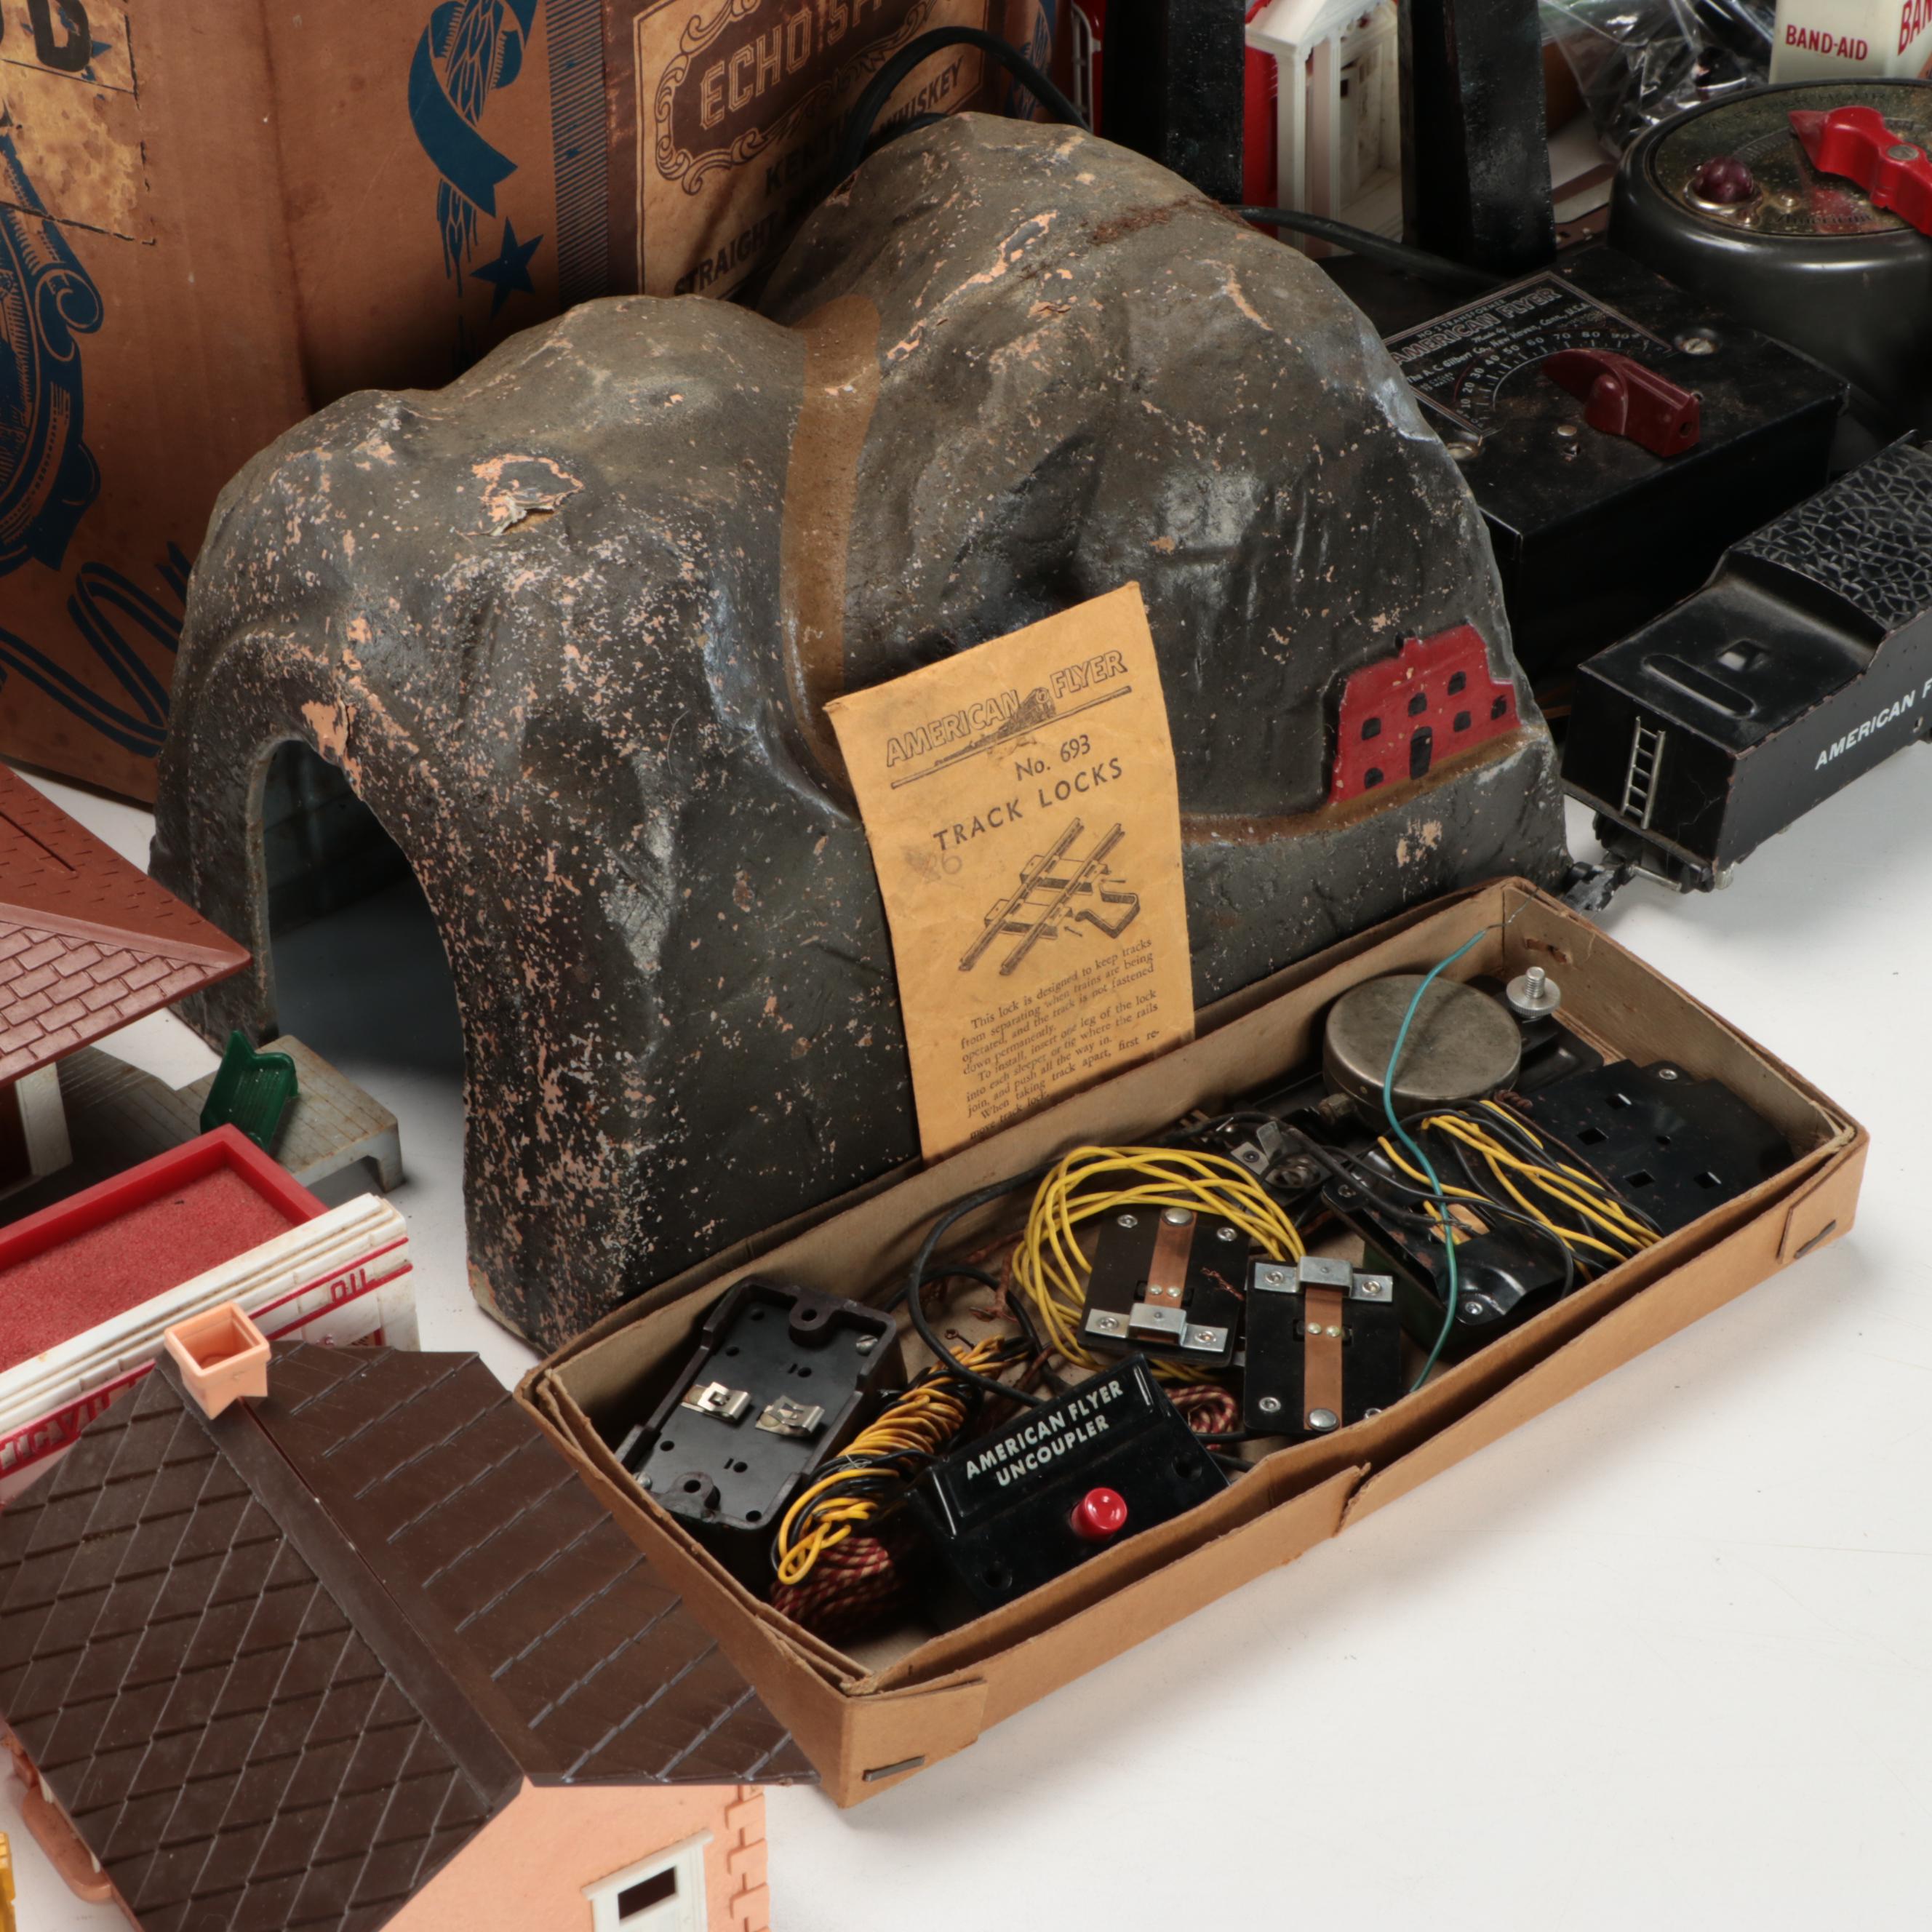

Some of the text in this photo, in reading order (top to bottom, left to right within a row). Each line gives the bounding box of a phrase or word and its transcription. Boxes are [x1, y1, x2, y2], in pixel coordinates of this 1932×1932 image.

[700, 6, 812, 130] ECHO
[1786, 24, 1869, 60] BAND-AID
[1391, 288, 1562, 365] AMERICAN FLYER
[1442, 299, 1506, 327] TRANSFORMER
[1502, 344, 1520, 354] 50
[1526, 337, 1544, 346] 60
[1462, 382, 1475, 393] 20
[1470, 367, 1484, 378] 30
[1485, 354, 1501, 365] 40
[1460, 398, 1471, 407] 10
[886, 650, 1128, 767] AMERICAN FLYER
[1815, 690, 1916, 770] AMERICAN
[1014, 734, 1091, 781] No. 693
[933, 757, 1122, 851] TRACK LOCKS
[961, 951, 1153, 1050] from separating when trains are being
[962, 963, 1154, 1064] operated, and the track is not fastened
[971, 938, 1152, 1030] This lock is designed to keep tracks
[963, 1023, 1056, 1075] down permanently.
[966, 1003, 1158, 1103] into each sleeper or tie where the rails
[978, 1070, 991, 1082] To
[1031, 1035, 1058, 1055] insert
[1061, 1026, 1077, 1039] one
[1081, 1015, 1096, 1030] leg
[1100, 1007, 1111, 1020] of
[1116, 1001, 1132, 1014] the
[1135, 989, 1157, 1005] lock
[967, 1036, 1112, 1119] join, and push all the way in.
[981, 1029, 1160, 1120] When taking track apart, first re-
[970, 1121, 996, 1140] move
[999, 1104, 1023, 1123] track
[330, 1268, 380, 1305] OIL
[965, 1380, 1124, 1480] AMERICAN FLYER
[996, 1414, 1109, 1488] UNCOUPLER
